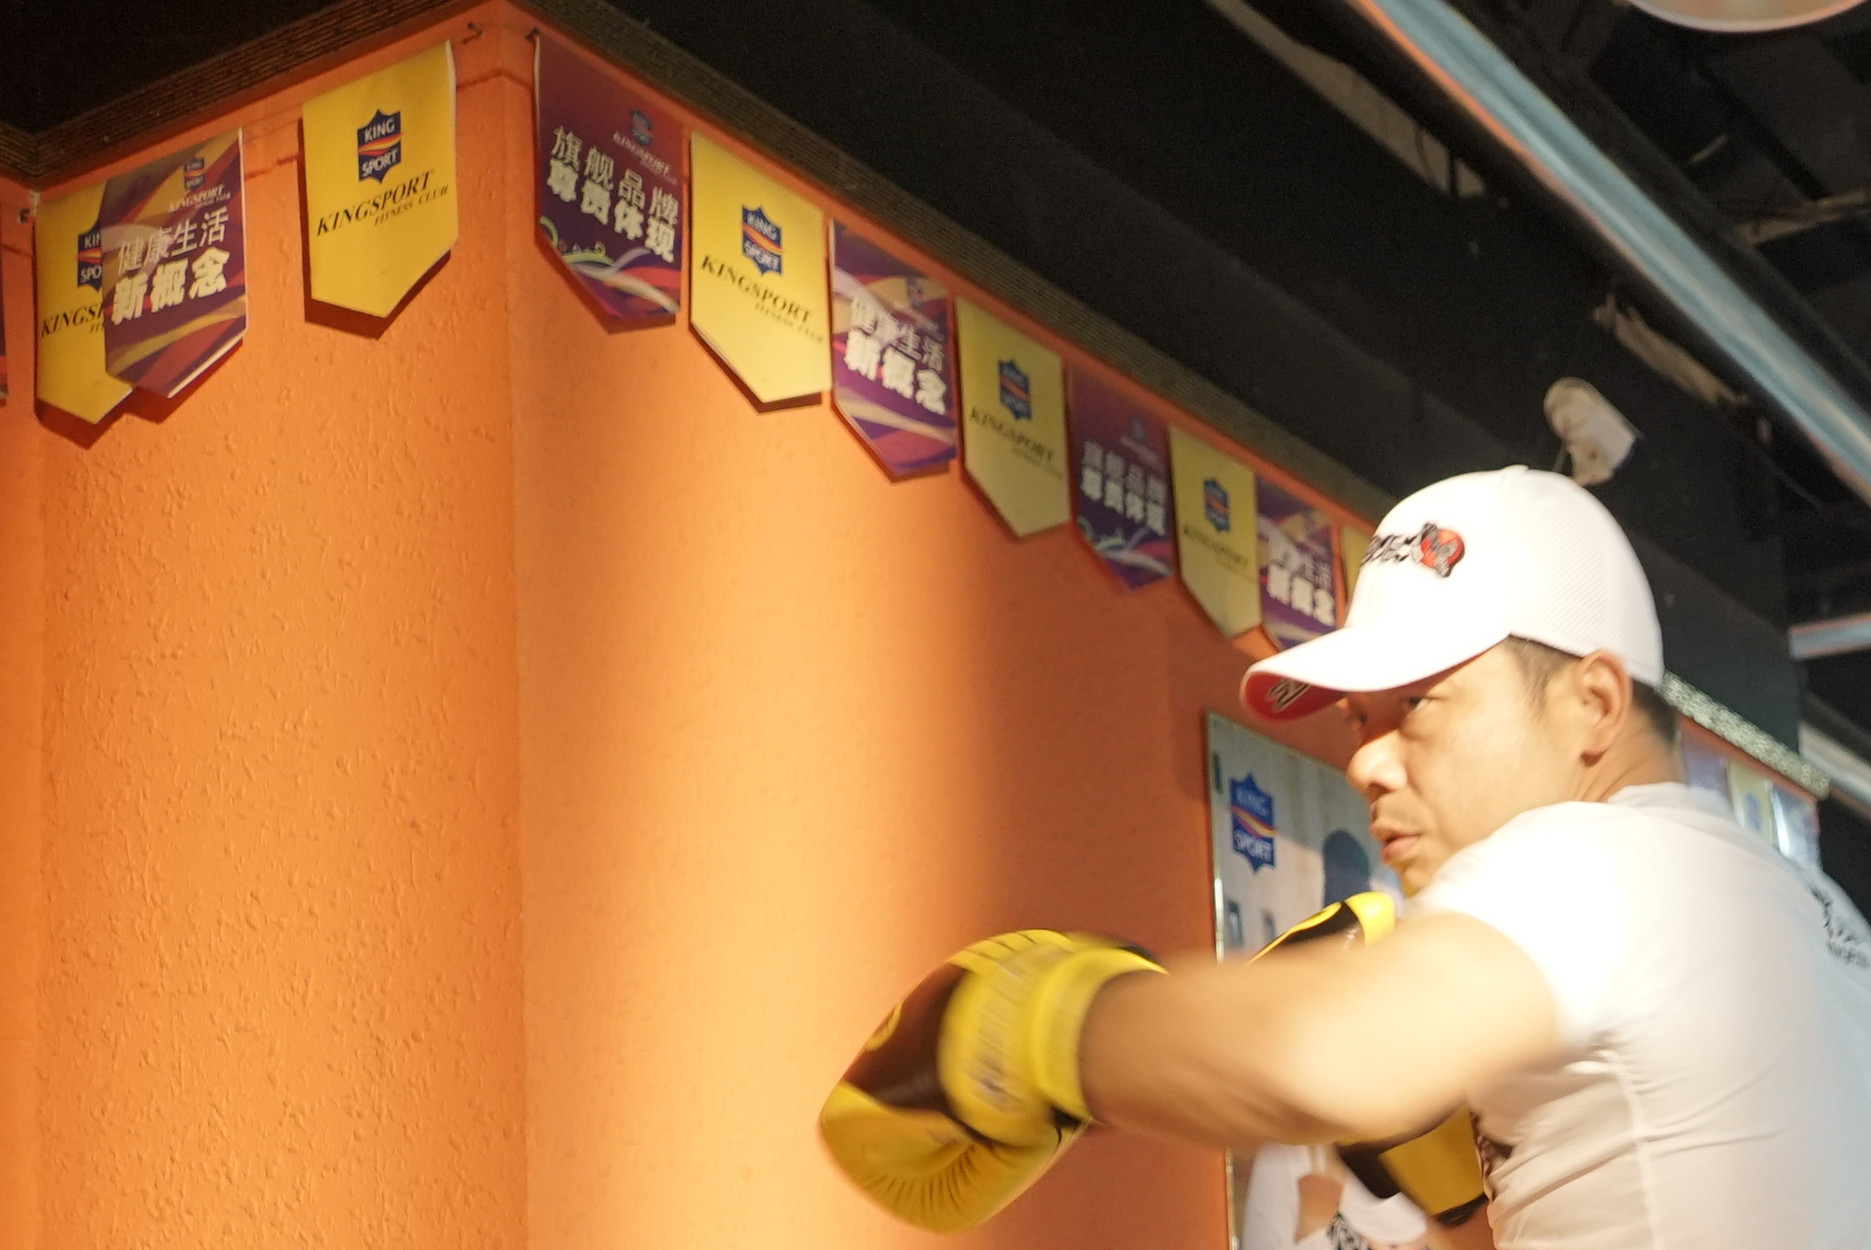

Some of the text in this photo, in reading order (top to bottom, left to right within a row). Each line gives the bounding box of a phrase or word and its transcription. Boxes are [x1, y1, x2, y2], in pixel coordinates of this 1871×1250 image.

[362, 148, 398, 178] SPORT
[364, 117, 395, 143] KING
[317, 170, 434, 236] KINGSPORT
[551, 126, 678, 225] 旗舰品牌
[118, 206, 229, 277] 健康生活
[743, 239, 780, 270] SPORT
[746, 211, 777, 241] KING
[111, 246, 230, 326] 新概念
[701, 254, 811, 323] KINGSPORT
